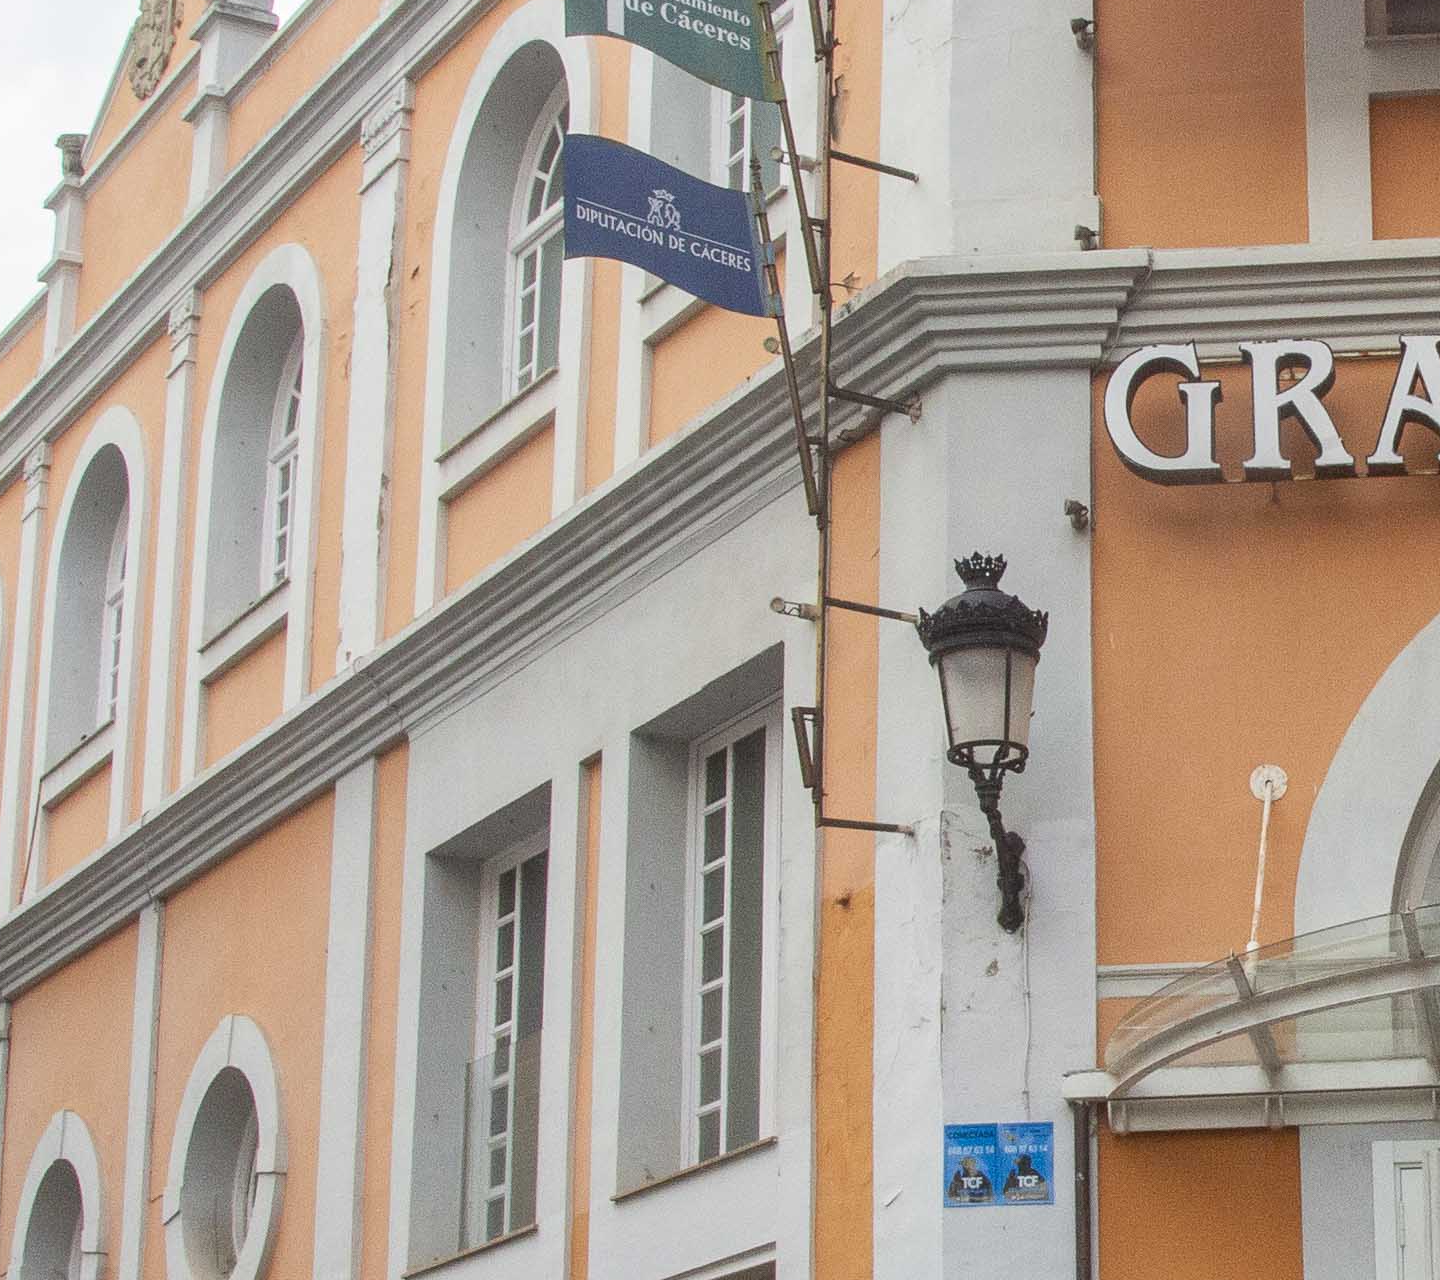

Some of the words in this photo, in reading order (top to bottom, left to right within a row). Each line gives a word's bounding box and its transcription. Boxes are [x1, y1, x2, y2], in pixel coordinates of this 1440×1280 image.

[660, 2, 751, 51] Cáceres
[576, 204, 664, 245] DIPUTACIÓN
[669, 235, 687, 253] DE
[690, 242, 752, 272] CÁCERES
[961, 1176, 984, 1190] TCF
[1017, 1175, 1039, 1188] TCF
